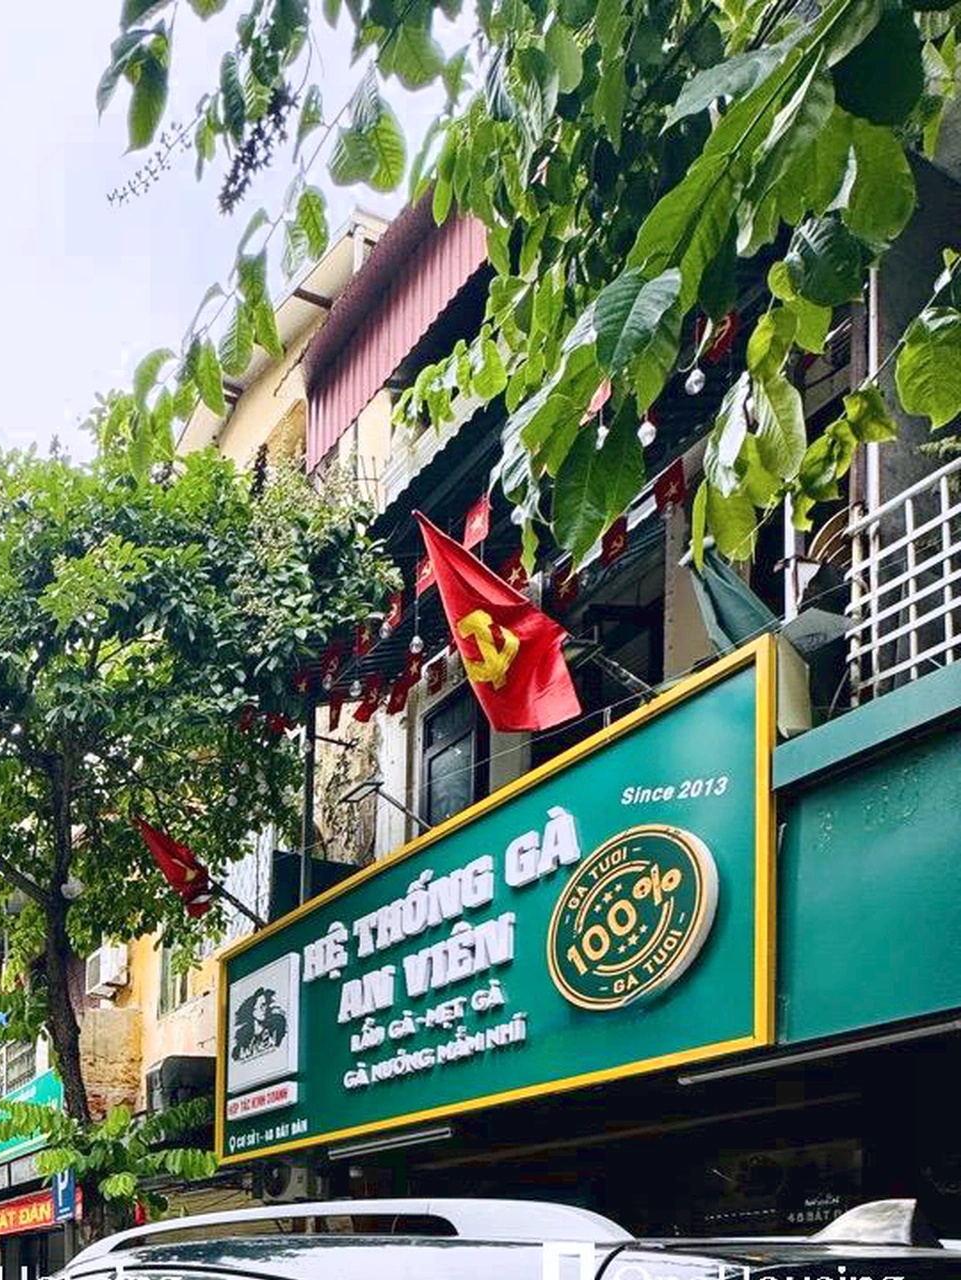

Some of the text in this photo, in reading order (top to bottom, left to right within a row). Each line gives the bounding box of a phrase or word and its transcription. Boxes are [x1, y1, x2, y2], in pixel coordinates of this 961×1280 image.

[621, 776, 729, 805] Since 2013
[303, 806, 581, 982] HỆ THỐNG GÀ
[567, 863, 682, 976] 100%
[338, 911, 516, 1023] AN VIÊN
[471, 979, 505, 1012] GÀ
[343, 1061, 370, 1089] GÀ
